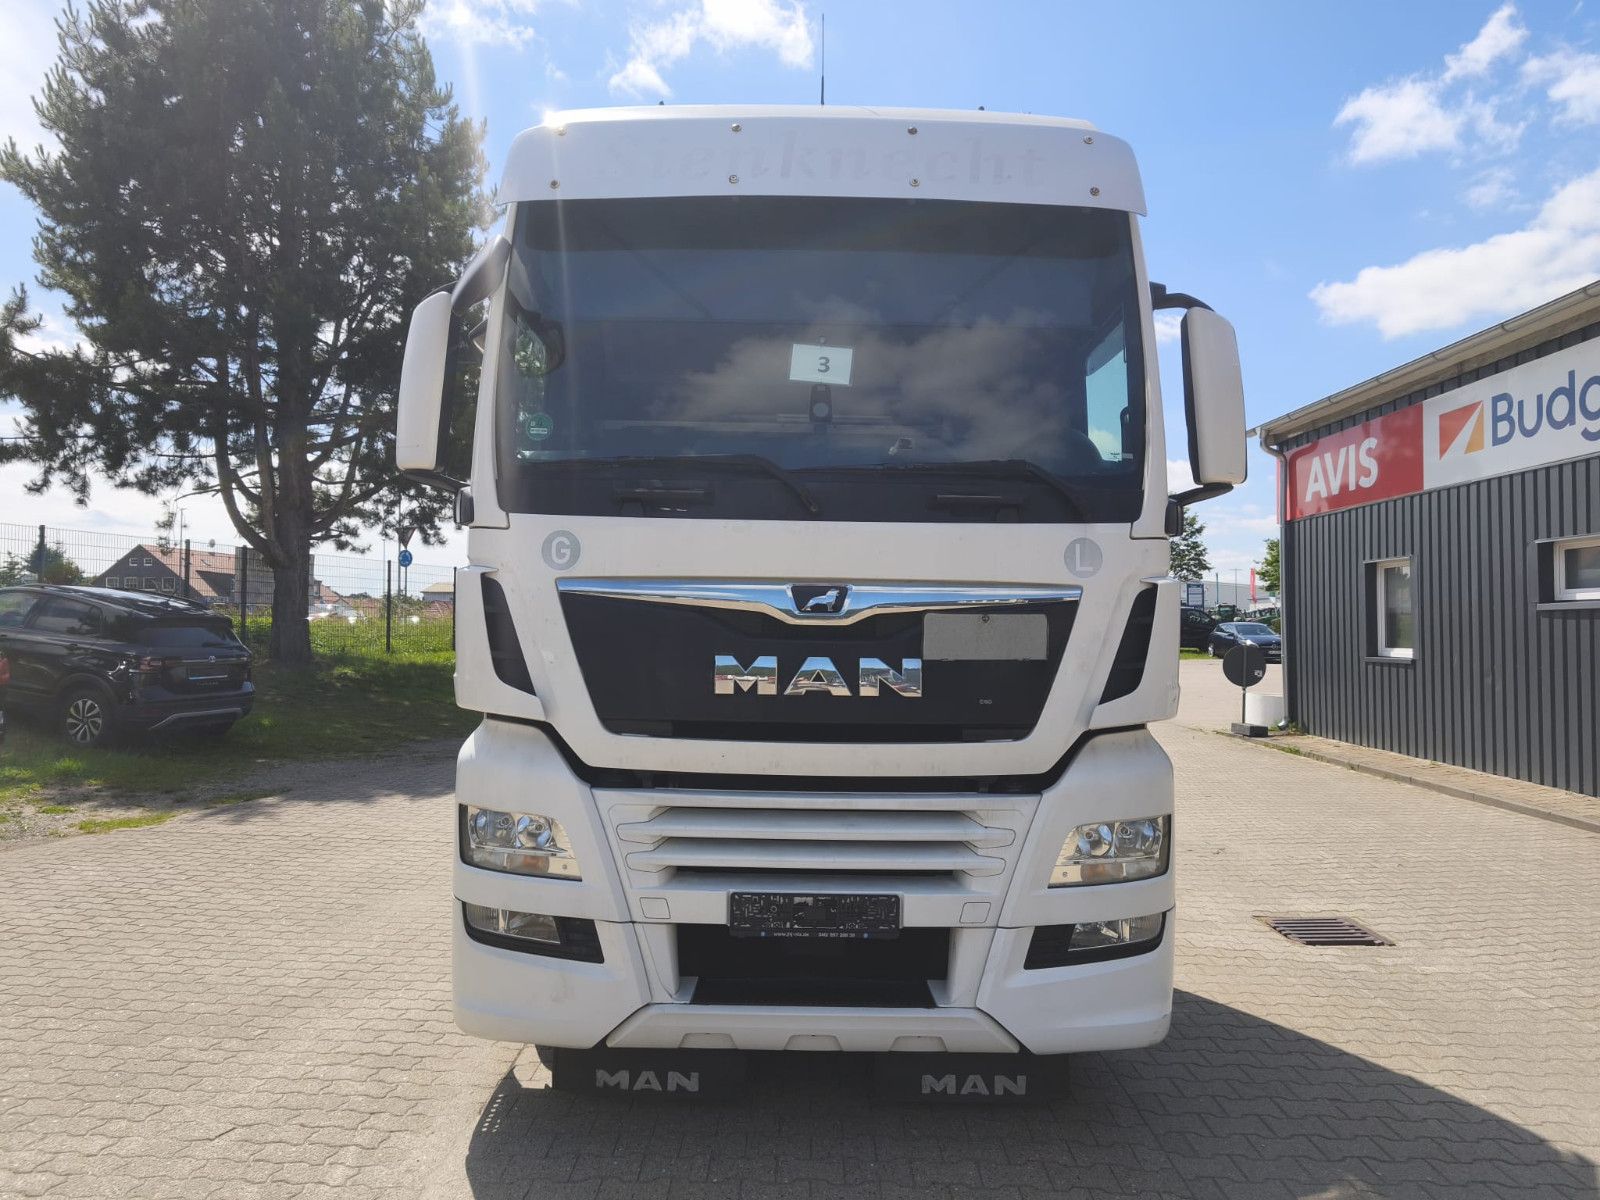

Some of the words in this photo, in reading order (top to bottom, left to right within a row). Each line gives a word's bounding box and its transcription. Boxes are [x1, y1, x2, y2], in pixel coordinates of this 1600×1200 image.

[817, 357, 830, 373] 3
[1305, 437, 1379, 502] AVIS
[551, 536, 571, 564] G
[1075, 543, 1093, 571] L
[714, 655, 923, 698] MAN
[595, 1070, 700, 1092] MAN
[921, 1074, 1027, 1096] MAN
